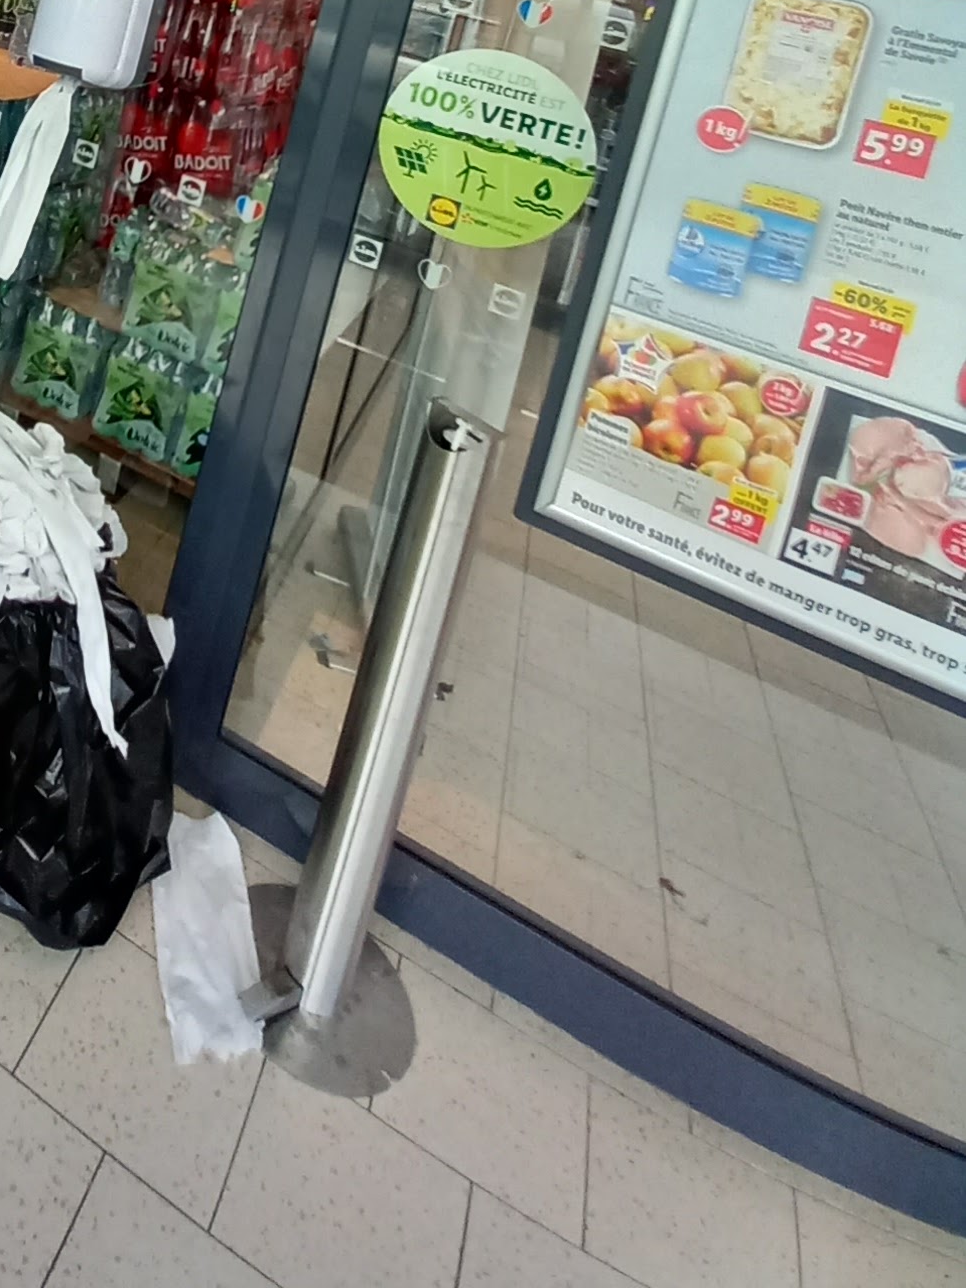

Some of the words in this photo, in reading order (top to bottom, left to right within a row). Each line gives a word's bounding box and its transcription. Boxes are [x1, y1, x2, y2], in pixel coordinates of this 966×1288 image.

[467, 62, 504, 80] CHEZ
[409, 82, 477, 119] 100%
[437, 68, 537, 105] L'ÉLECTRICITÉ
[539, 96, 566, 111] EST
[705, 119, 714, 133] 1
[715, 122, 737, 141] kg
[859, 129, 925, 166] 5.99
[174, 154, 232, 172] BADOIT
[834, 288, 888, 315] -60%
[810, 321, 867, 356] 2.27
[710, 504, 755, 529] 2.99
[791, 538, 834, 563] 4.47
[571, 491, 606, 516] Pour
[608, 509, 646, 534] votre
[648, 527, 692, 558] santé,
[695, 547, 742, 578] évitez
[745, 567, 766, 588] de
[769, 580, 833, 616] manger
[836, 609, 871, 634] trop
[921, 642, 959, 671] trop
